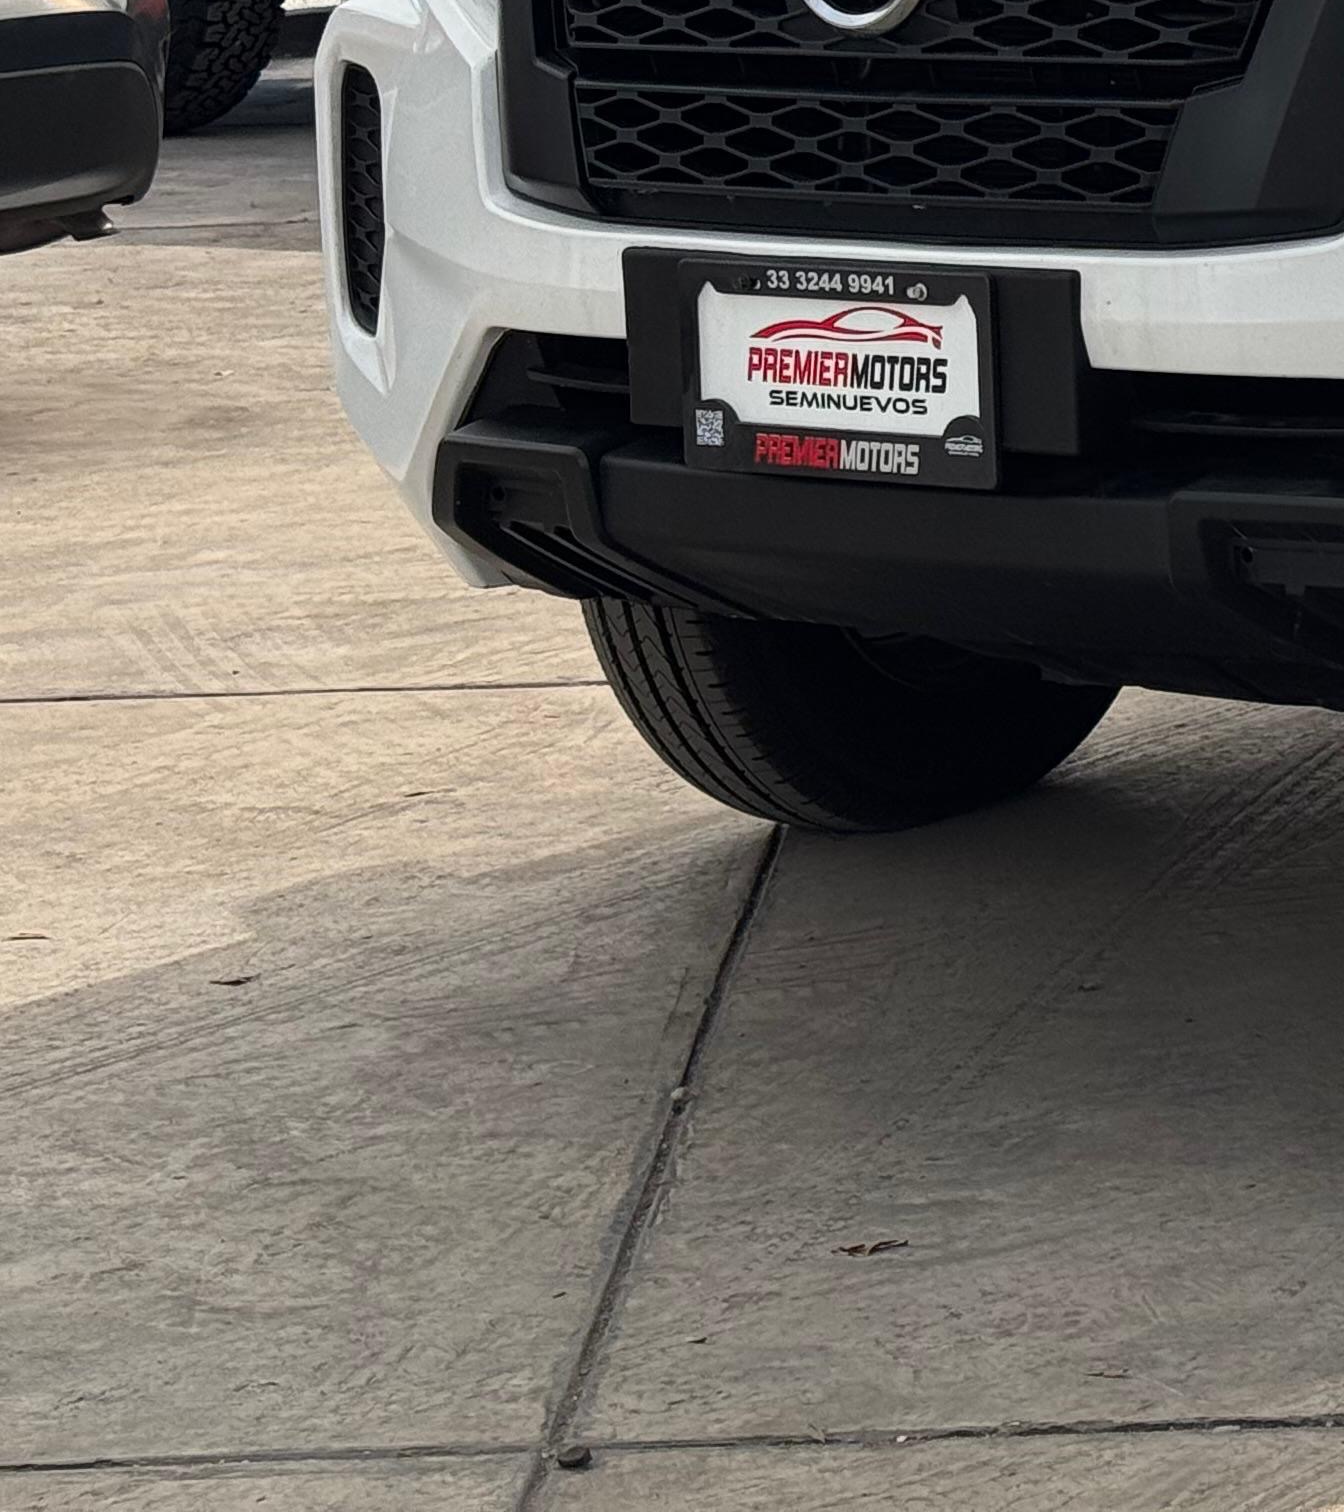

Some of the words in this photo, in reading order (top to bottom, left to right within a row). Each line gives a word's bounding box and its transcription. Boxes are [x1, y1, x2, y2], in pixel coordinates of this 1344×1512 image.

[766, 269, 790, 289] 33
[795, 270, 843, 292] 3244
[848, 273, 895, 295] 9941
[747, 347, 948, 393] PREMIERMOTORS
[769, 389, 928, 415] SEMINUEVOS
[754, 433, 920, 475] PREMIERMOTORS
